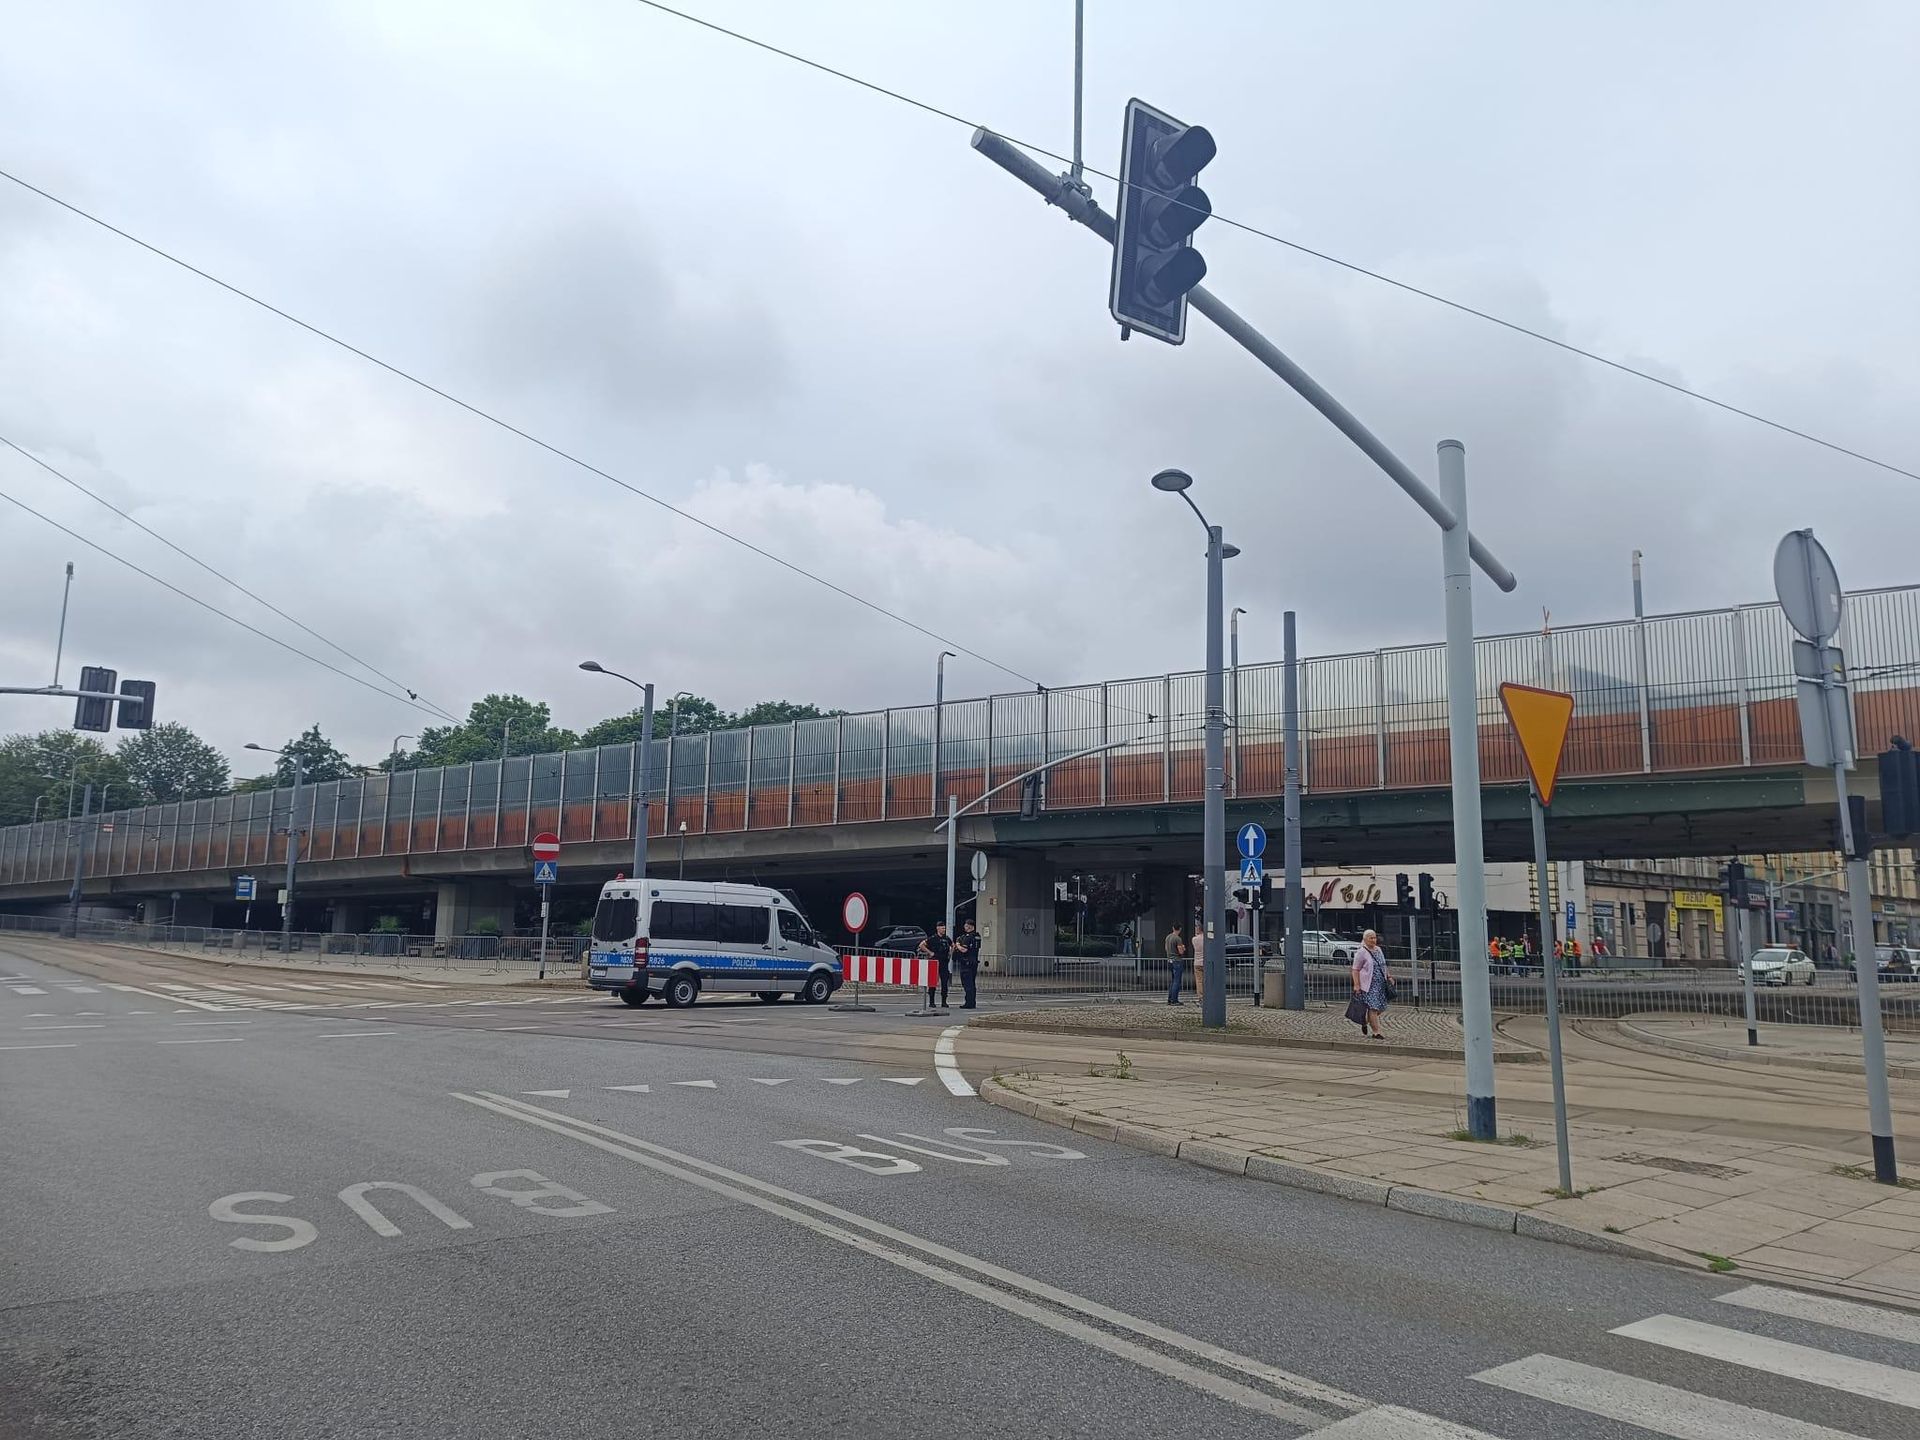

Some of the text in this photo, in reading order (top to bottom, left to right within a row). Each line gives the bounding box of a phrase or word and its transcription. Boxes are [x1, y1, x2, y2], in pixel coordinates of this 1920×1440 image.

[731, 959, 757, 967] POLICJA
[770, 1127, 1091, 1176] BUS
[208, 1168, 618, 1253] BUS
